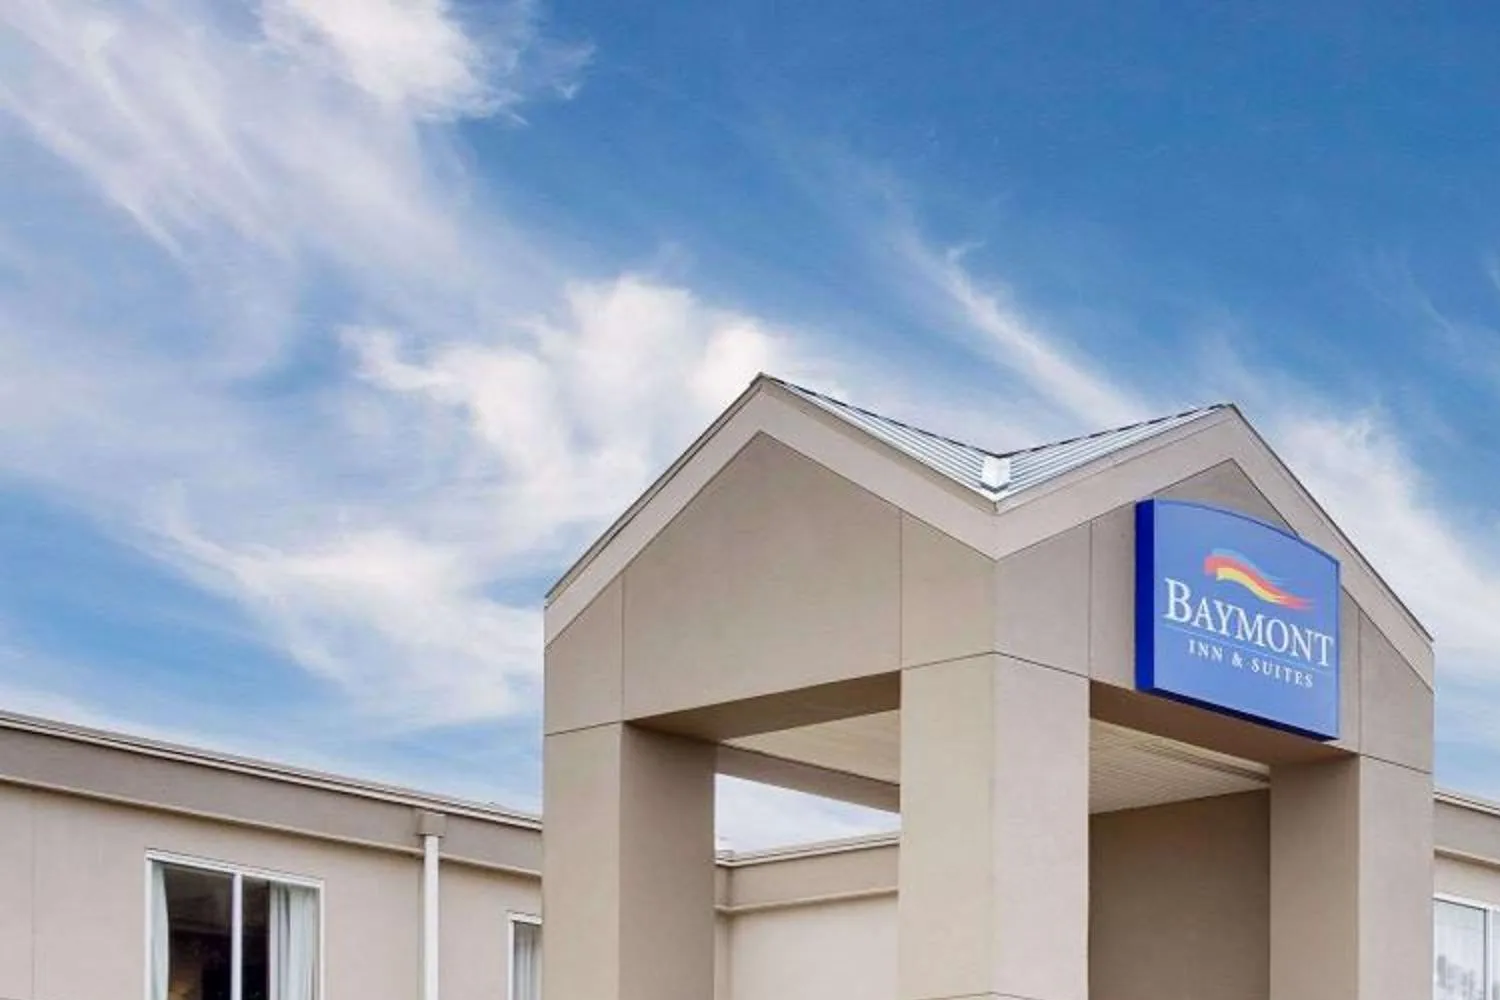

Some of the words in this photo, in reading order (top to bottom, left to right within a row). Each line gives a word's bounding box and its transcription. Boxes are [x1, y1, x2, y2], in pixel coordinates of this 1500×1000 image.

[1164, 577, 1334, 667] BAYMONT
[1188, 639, 1223, 663] INN
[1231, 651, 1243, 669] &
[1250, 656, 1314, 689] SUITES
